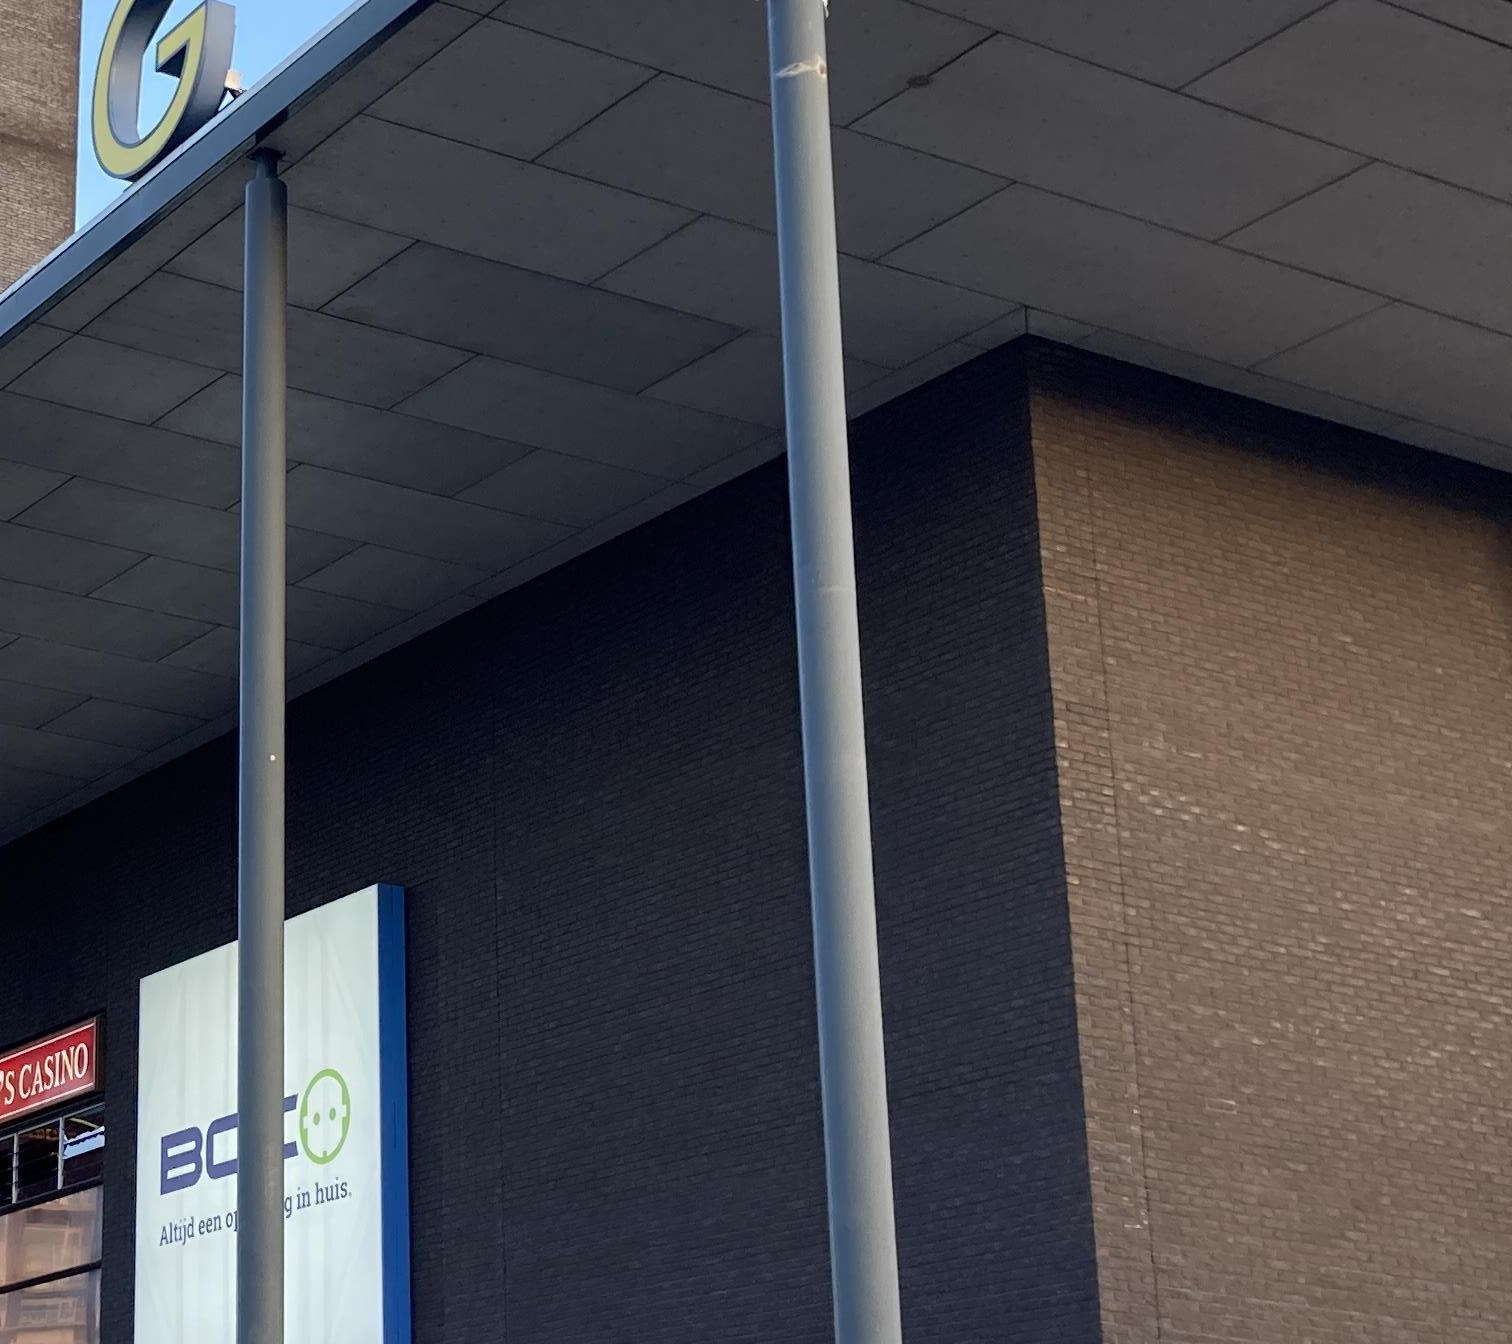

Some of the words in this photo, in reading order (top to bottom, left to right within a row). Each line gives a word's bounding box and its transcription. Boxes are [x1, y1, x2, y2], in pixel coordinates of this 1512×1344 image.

[18, 1042, 89, 1100] CASINO
[159, 1216, 196, 1247] Altijd
[198, 1209, 222, 1236] een
[296, 1186, 311, 1210] in
[315, 1176, 352, 1205] huis.
